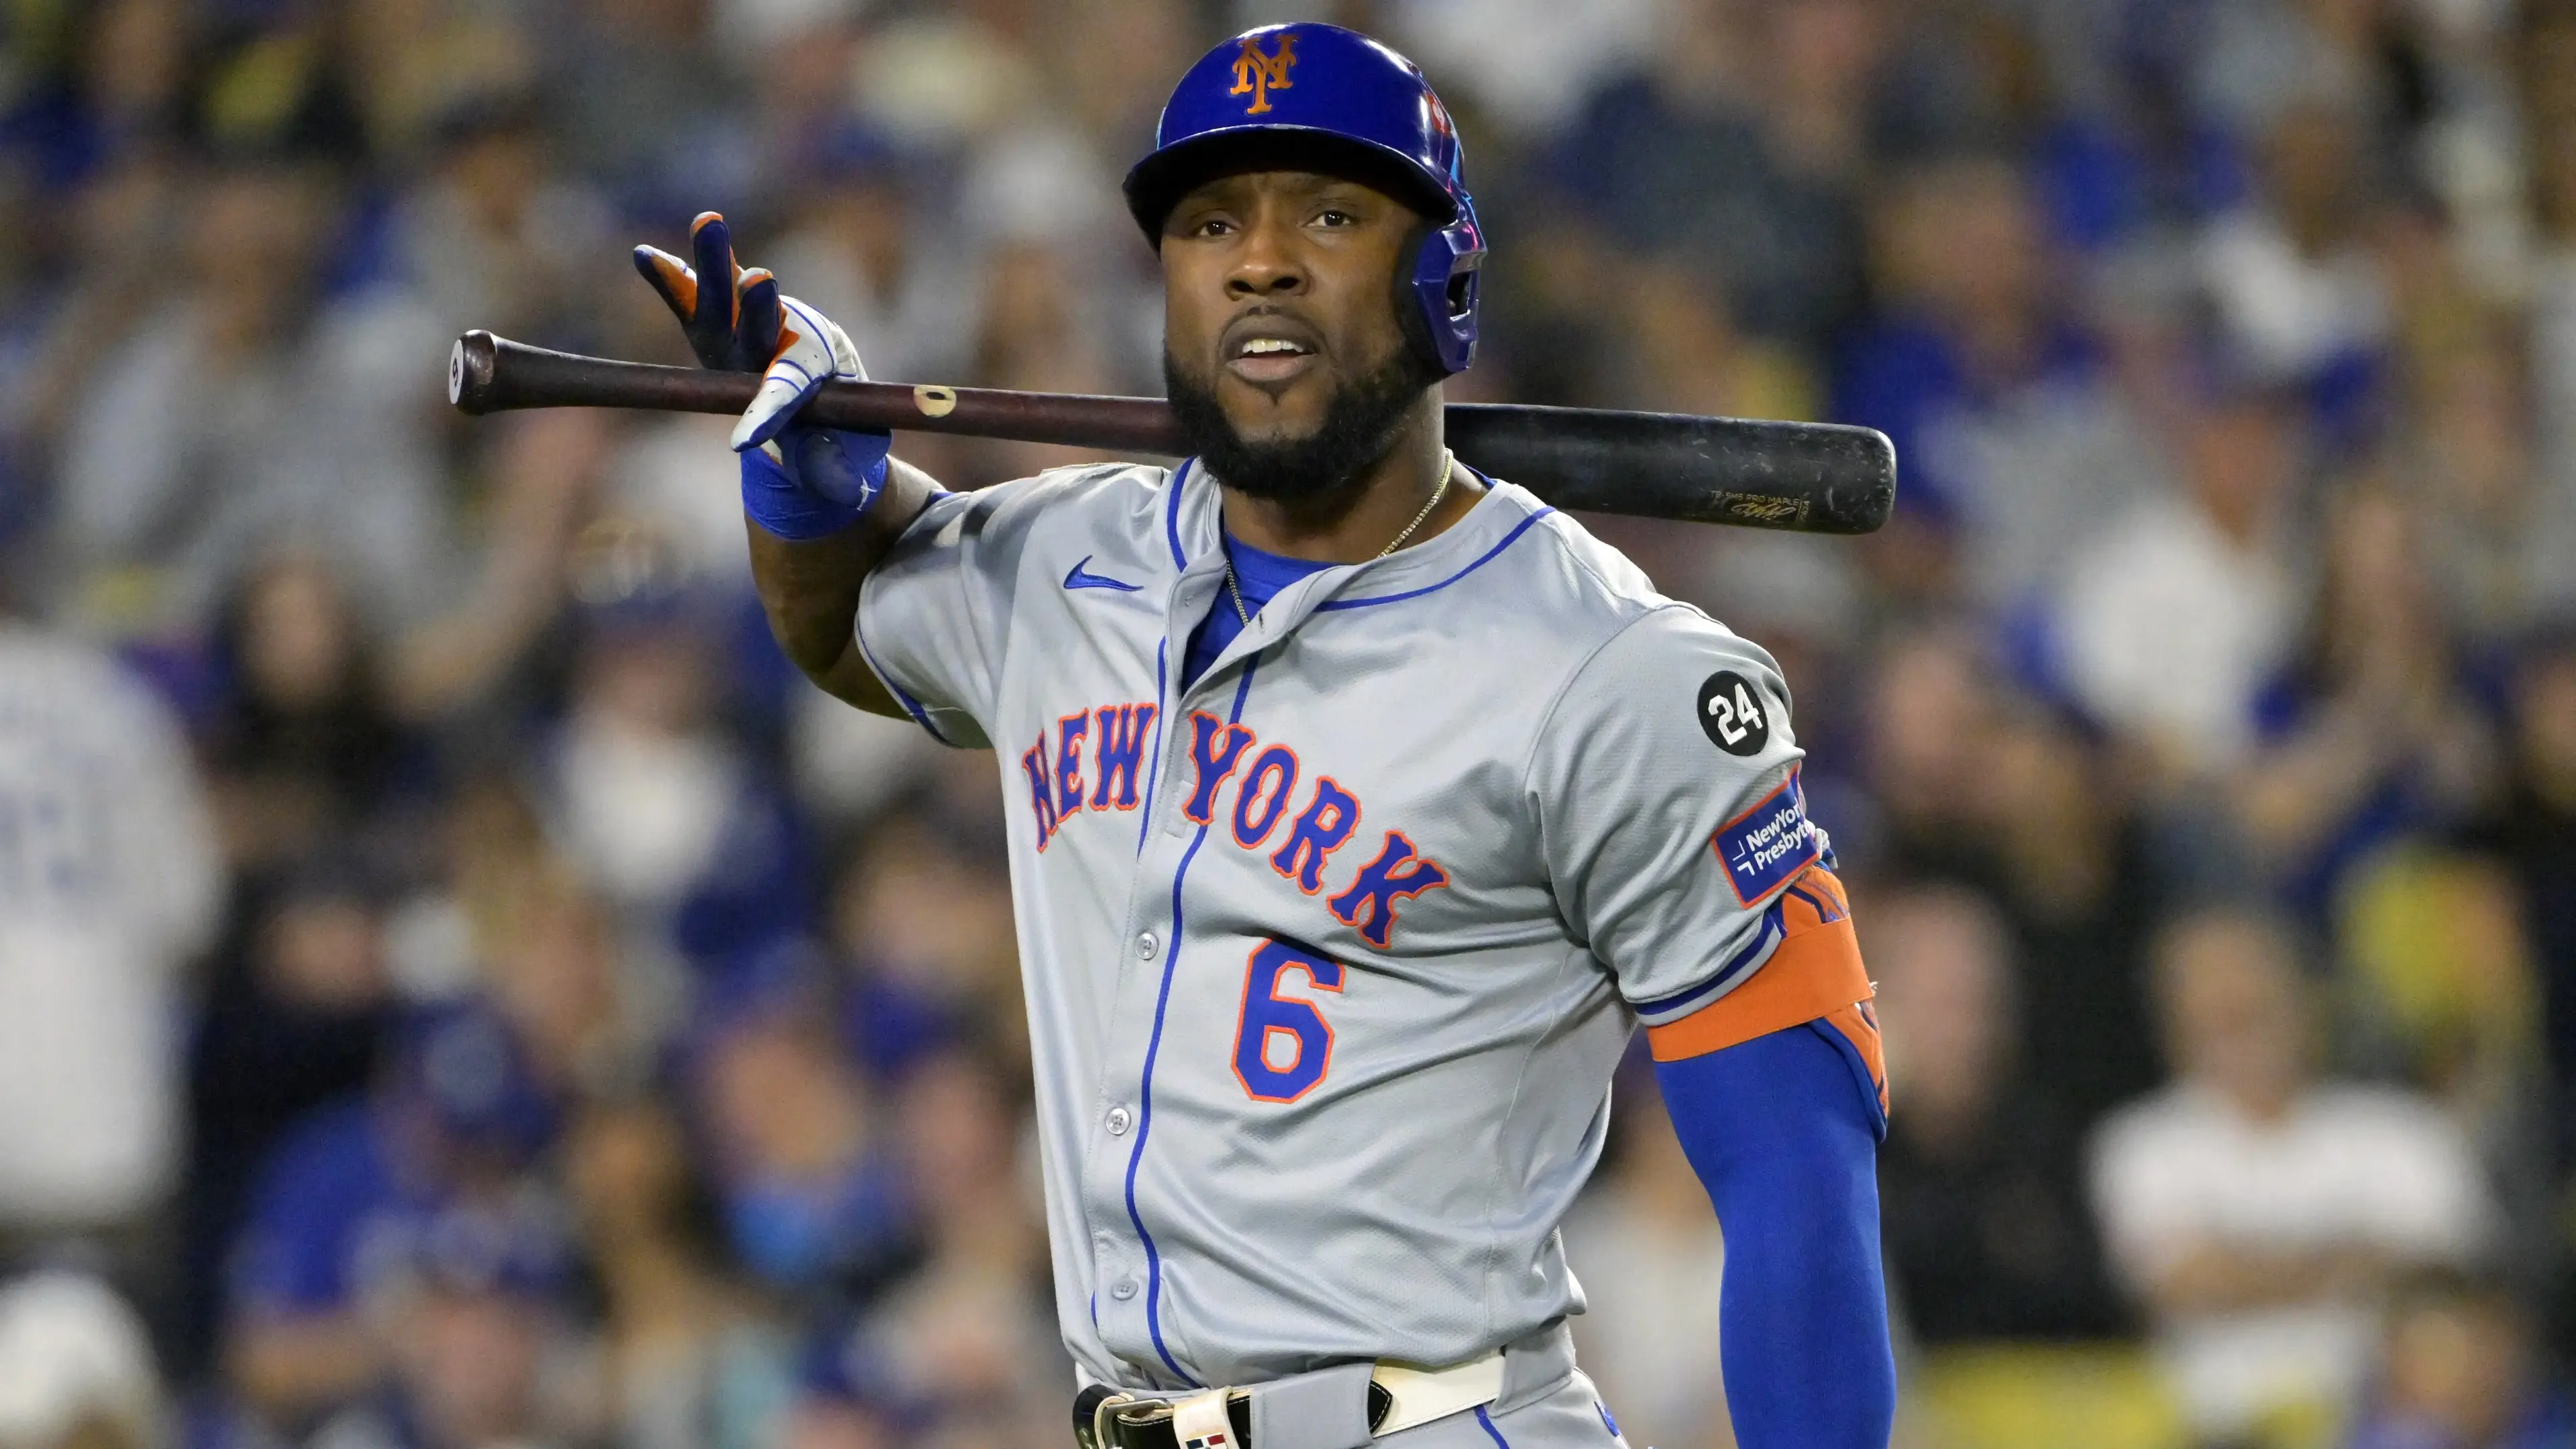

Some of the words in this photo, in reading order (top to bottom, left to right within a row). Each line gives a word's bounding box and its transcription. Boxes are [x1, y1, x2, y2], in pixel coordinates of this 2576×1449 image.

[1746, 493, 1766, 503] PRO
[1708, 683, 1762, 745] 24
[1022, 702, 1159, 853] NEW
[1182, 710, 1449, 949] YORK
[1746, 797, 1805, 851] NewYor
[1754, 821, 1809, 869] Presbyt
[1230, 938, 1346, 1104] 6
